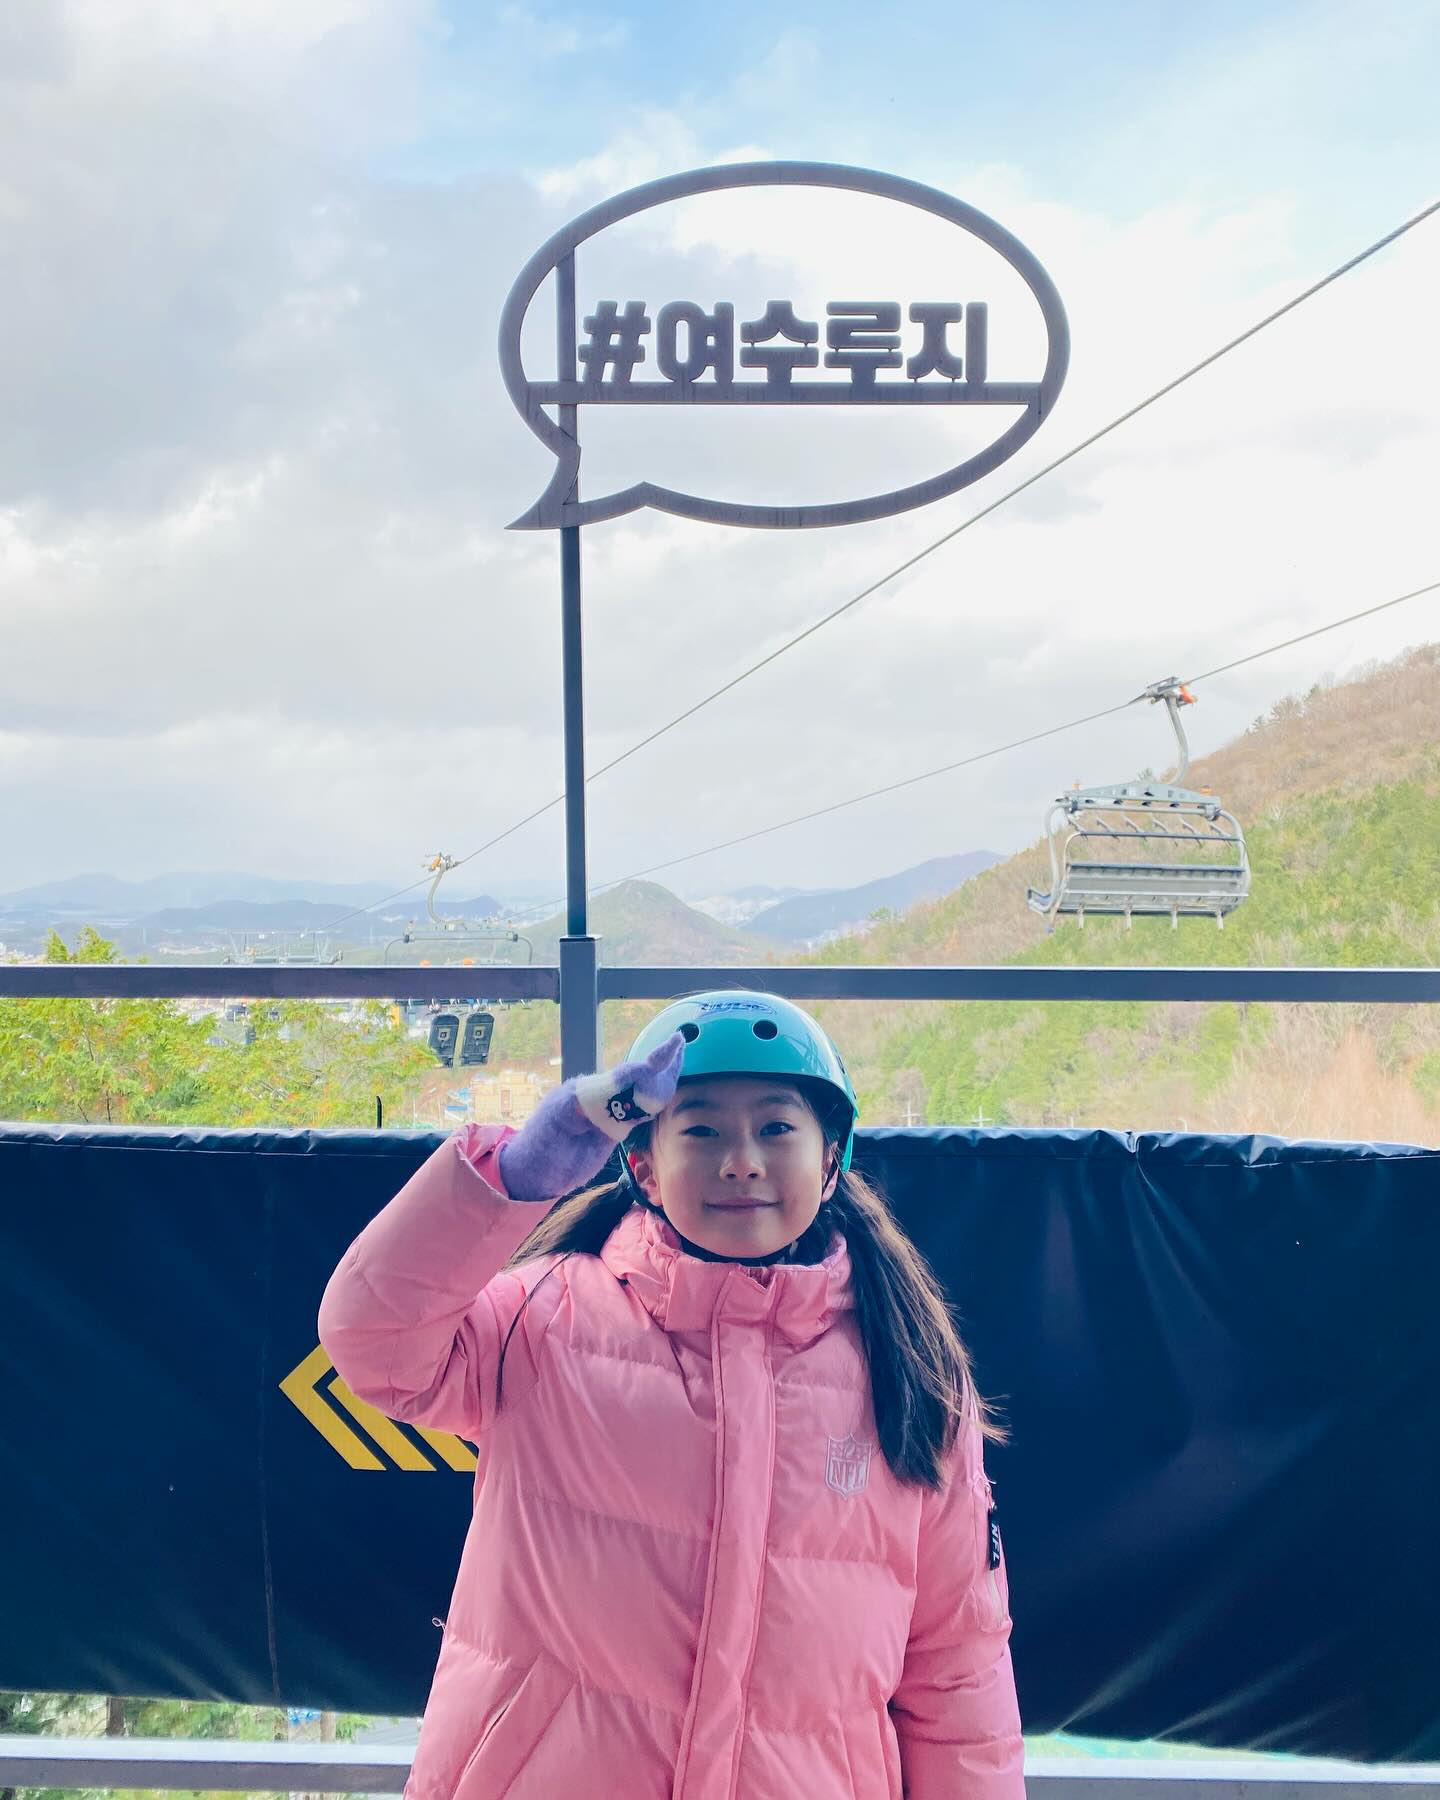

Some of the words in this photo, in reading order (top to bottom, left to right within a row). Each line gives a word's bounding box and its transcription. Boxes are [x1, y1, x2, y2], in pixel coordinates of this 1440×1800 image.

[578, 301, 988, 383] #여수루지
[830, 1459, 866, 1489] NFL
[991, 1523, 1000, 1562] NFL
